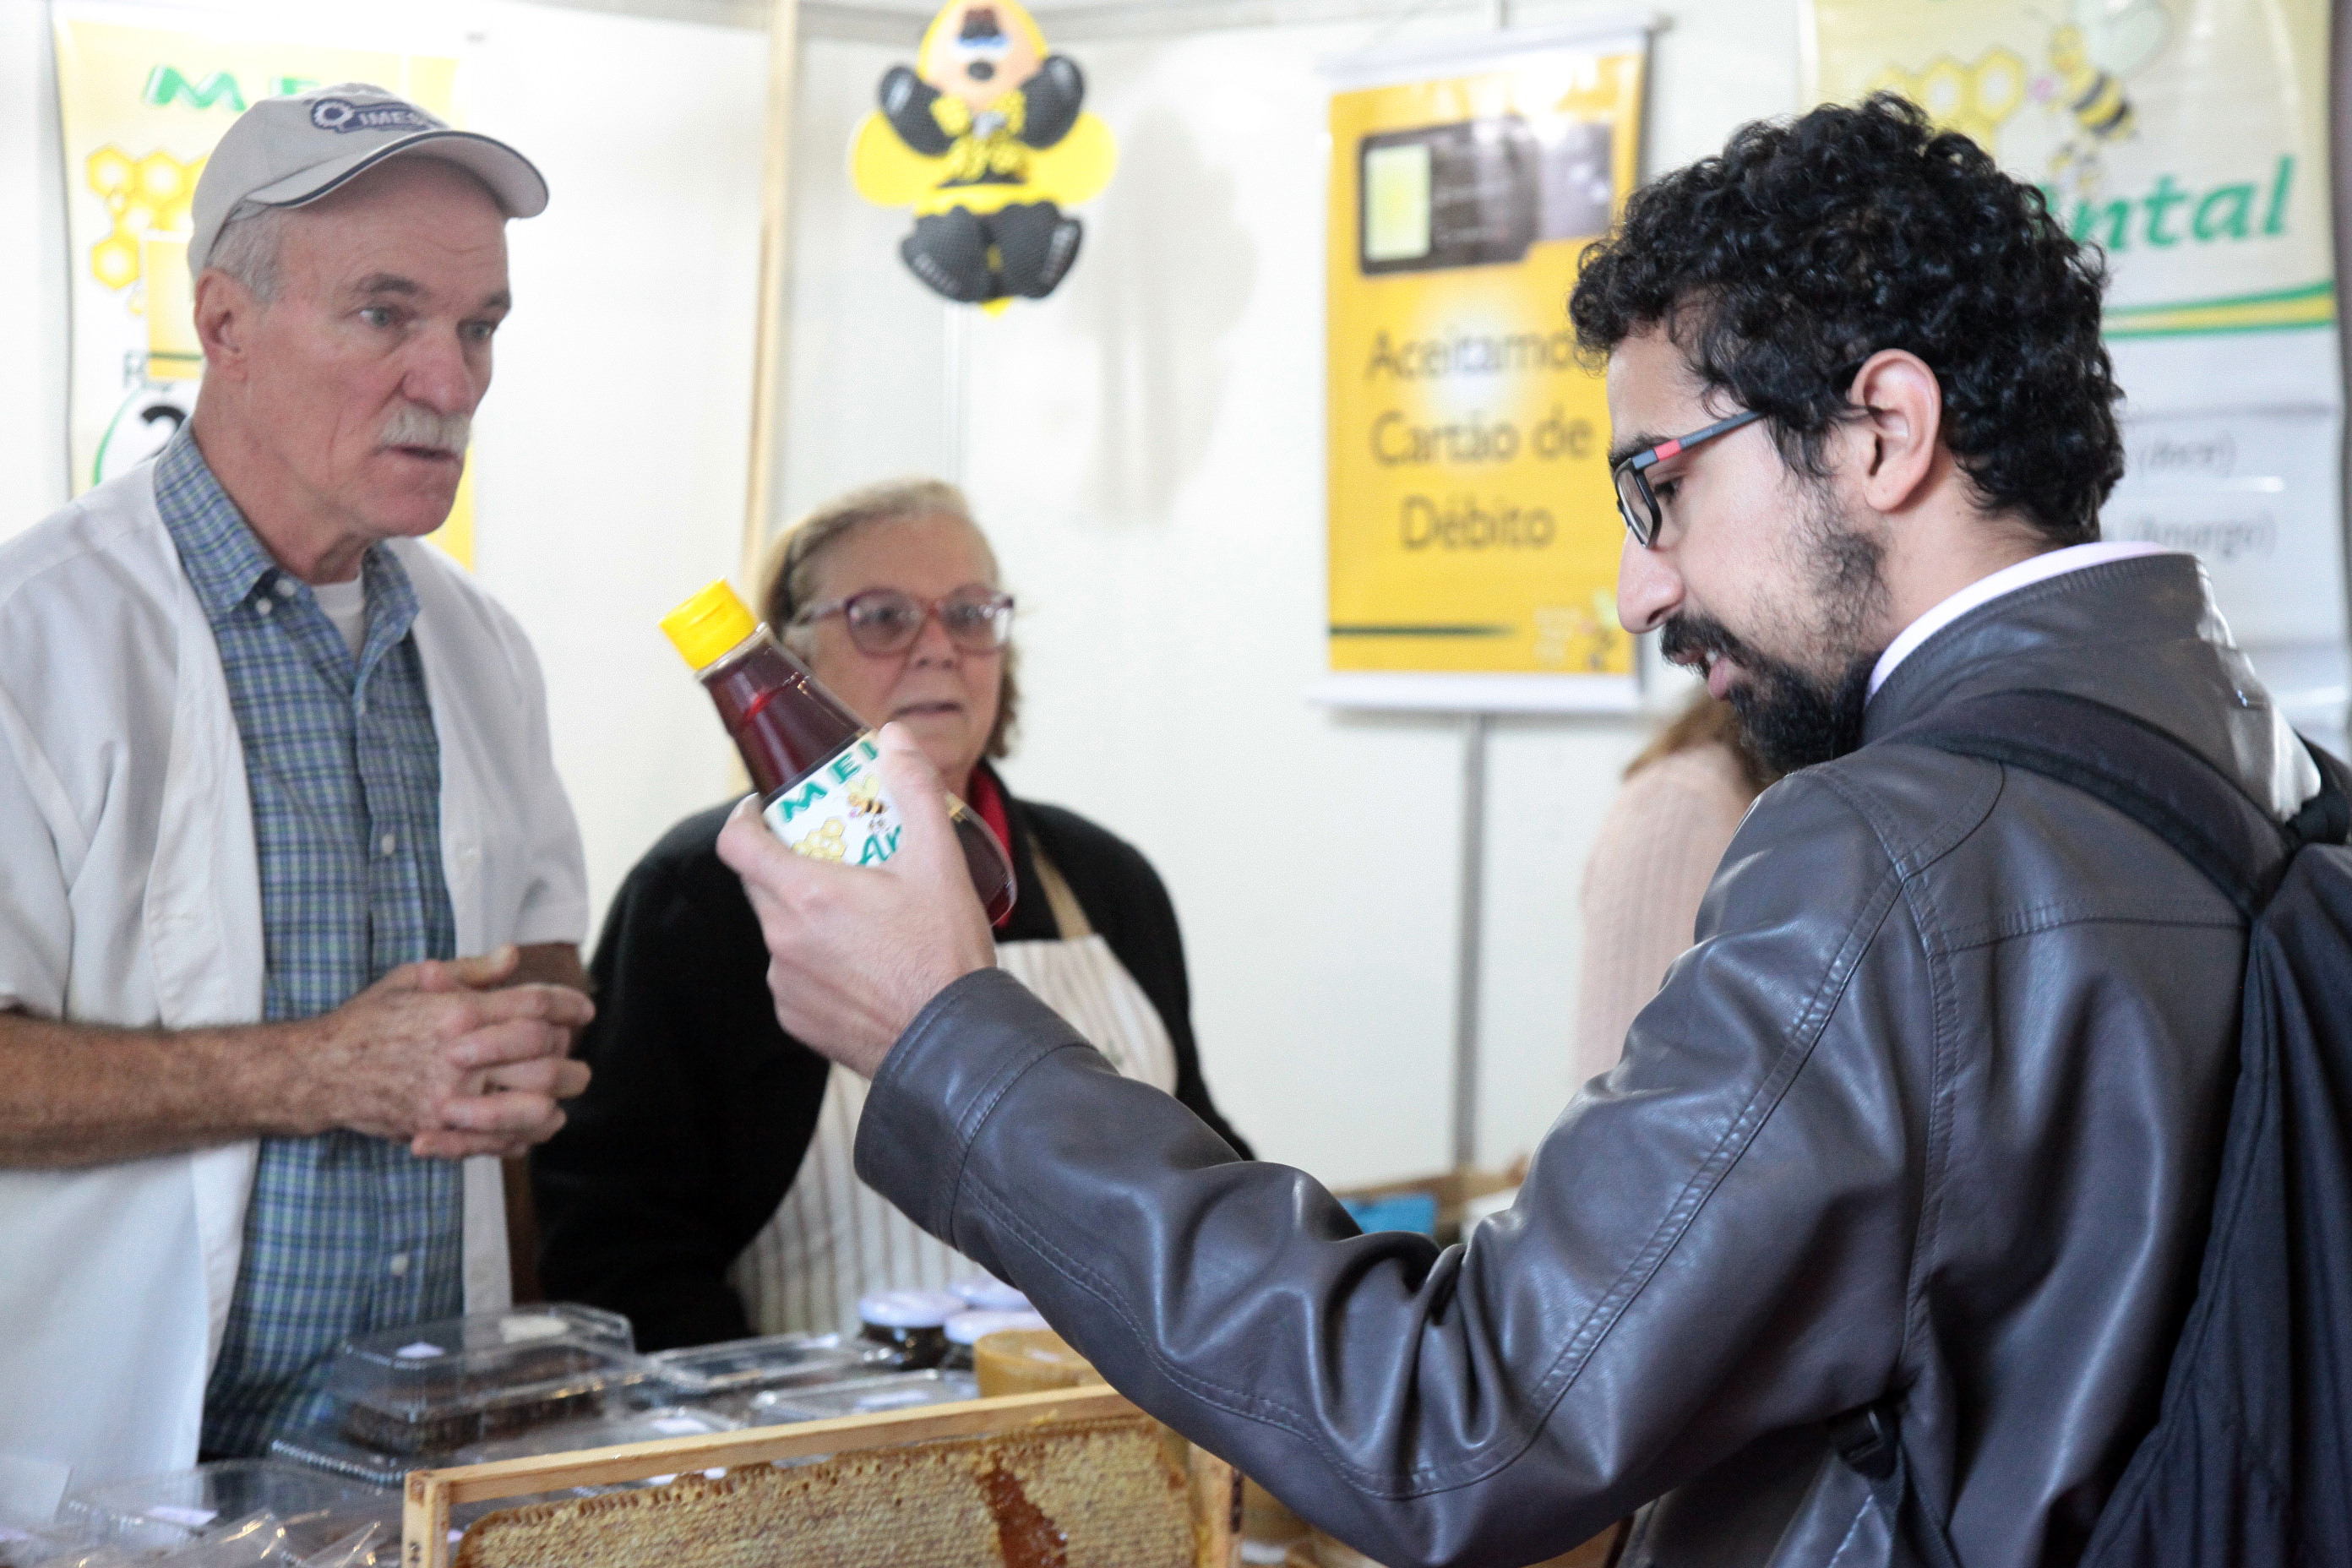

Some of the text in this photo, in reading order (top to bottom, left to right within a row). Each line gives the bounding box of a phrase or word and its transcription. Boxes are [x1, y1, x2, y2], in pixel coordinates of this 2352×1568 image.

[1364, 324, 1588, 380] Aceitamo
[1369, 400, 1595, 467] Cartão de
[1399, 493, 1558, 552] Débito
